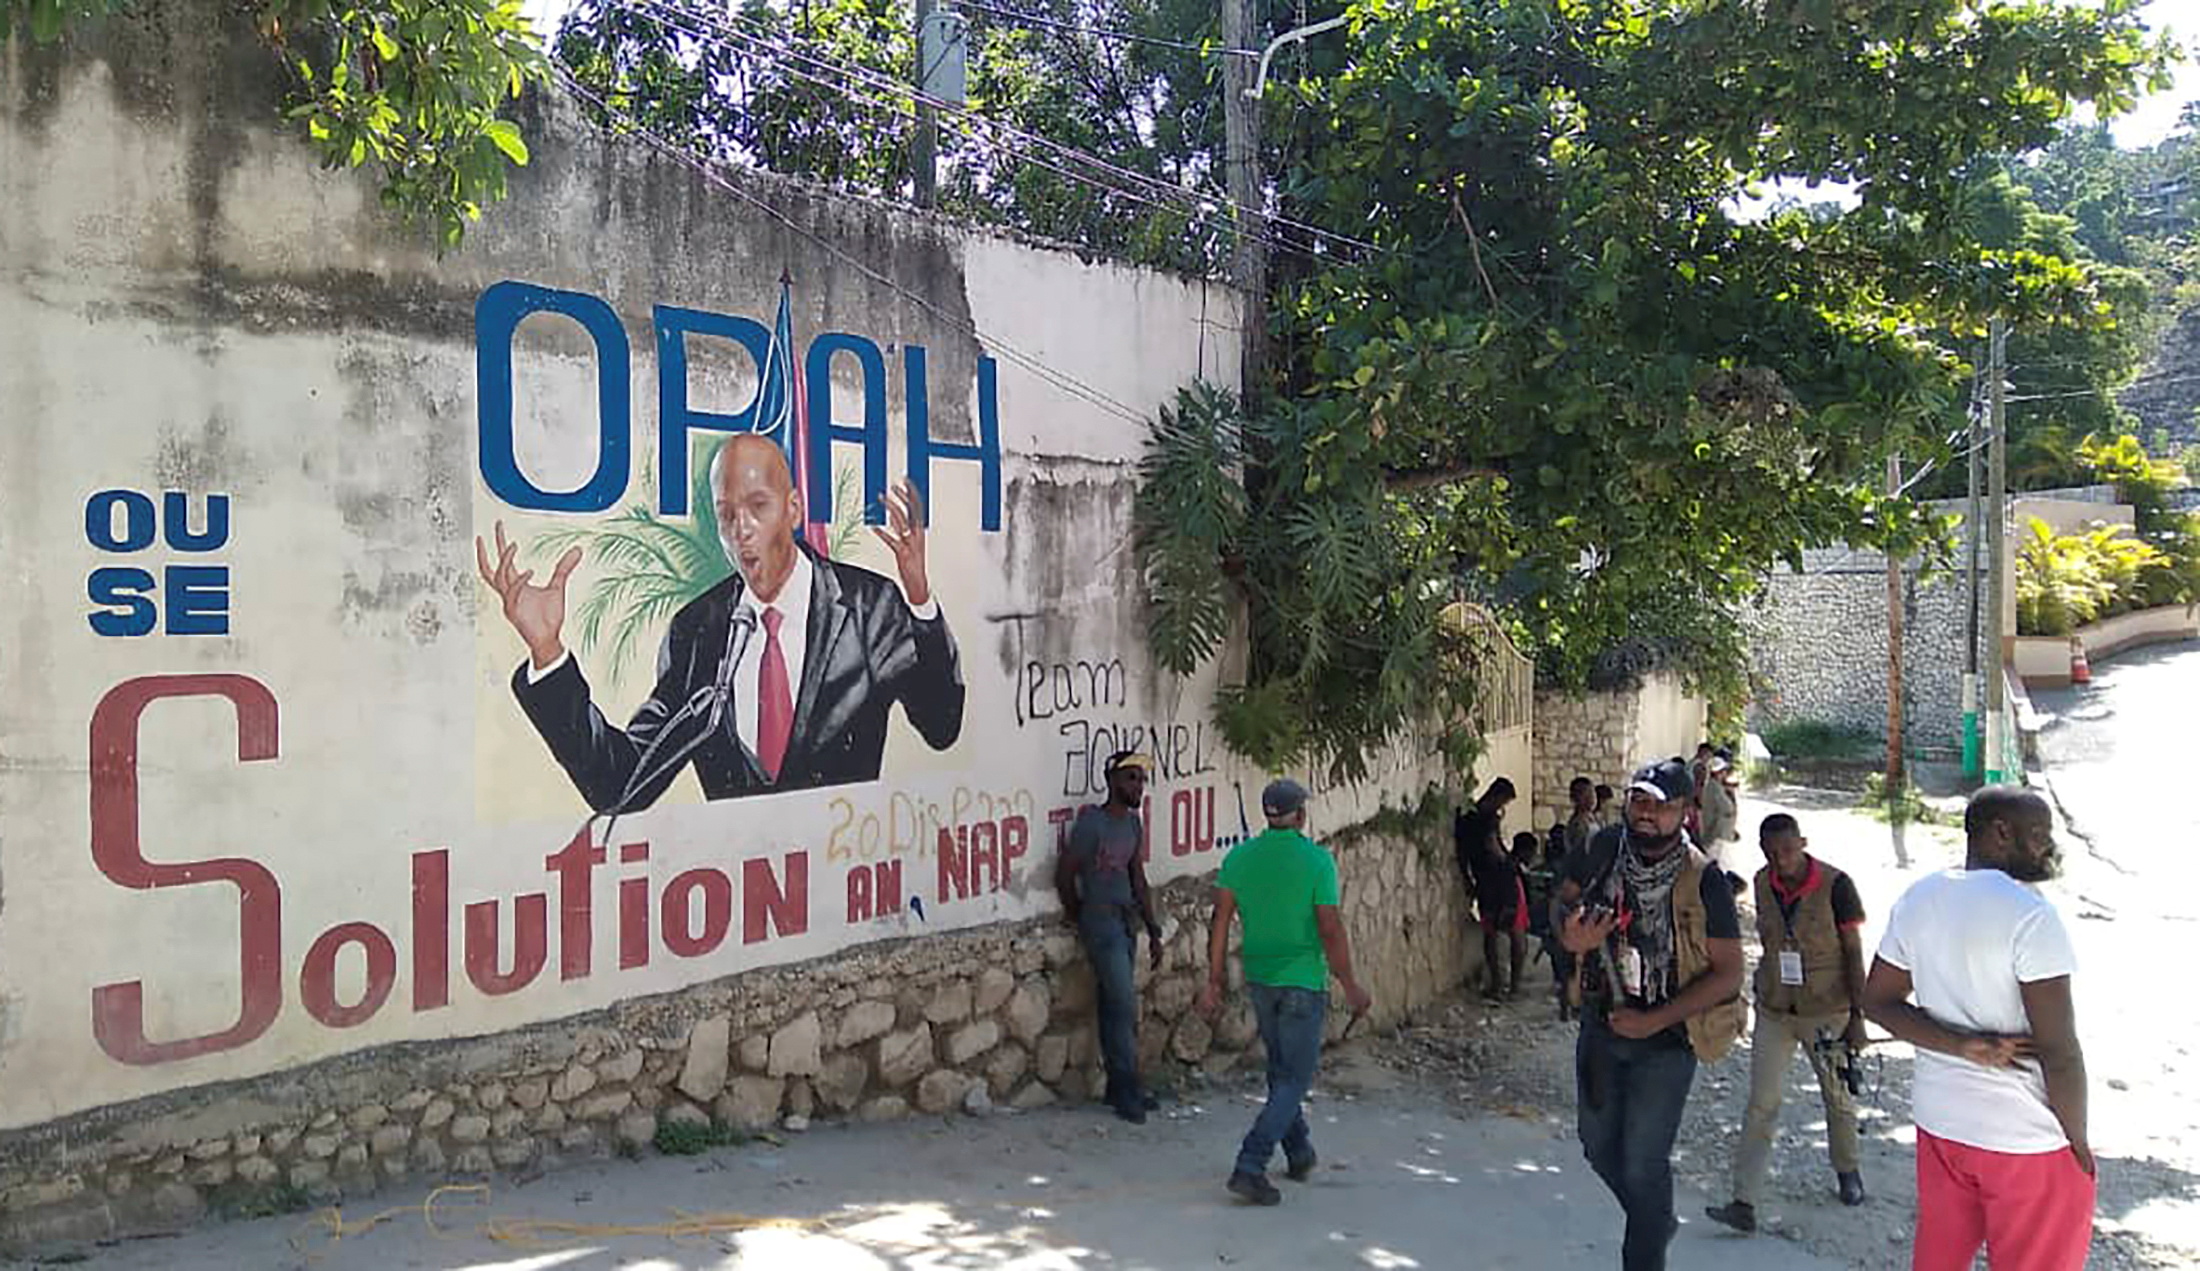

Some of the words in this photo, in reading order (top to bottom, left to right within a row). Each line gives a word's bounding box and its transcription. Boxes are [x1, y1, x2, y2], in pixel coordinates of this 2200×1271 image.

[475, 280, 1001, 532] OPAH
[86, 490, 229, 552] OU
[88, 566, 229, 636] SE
[985, 614, 1126, 727] Team
[937, 815, 1029, 905] NAP
